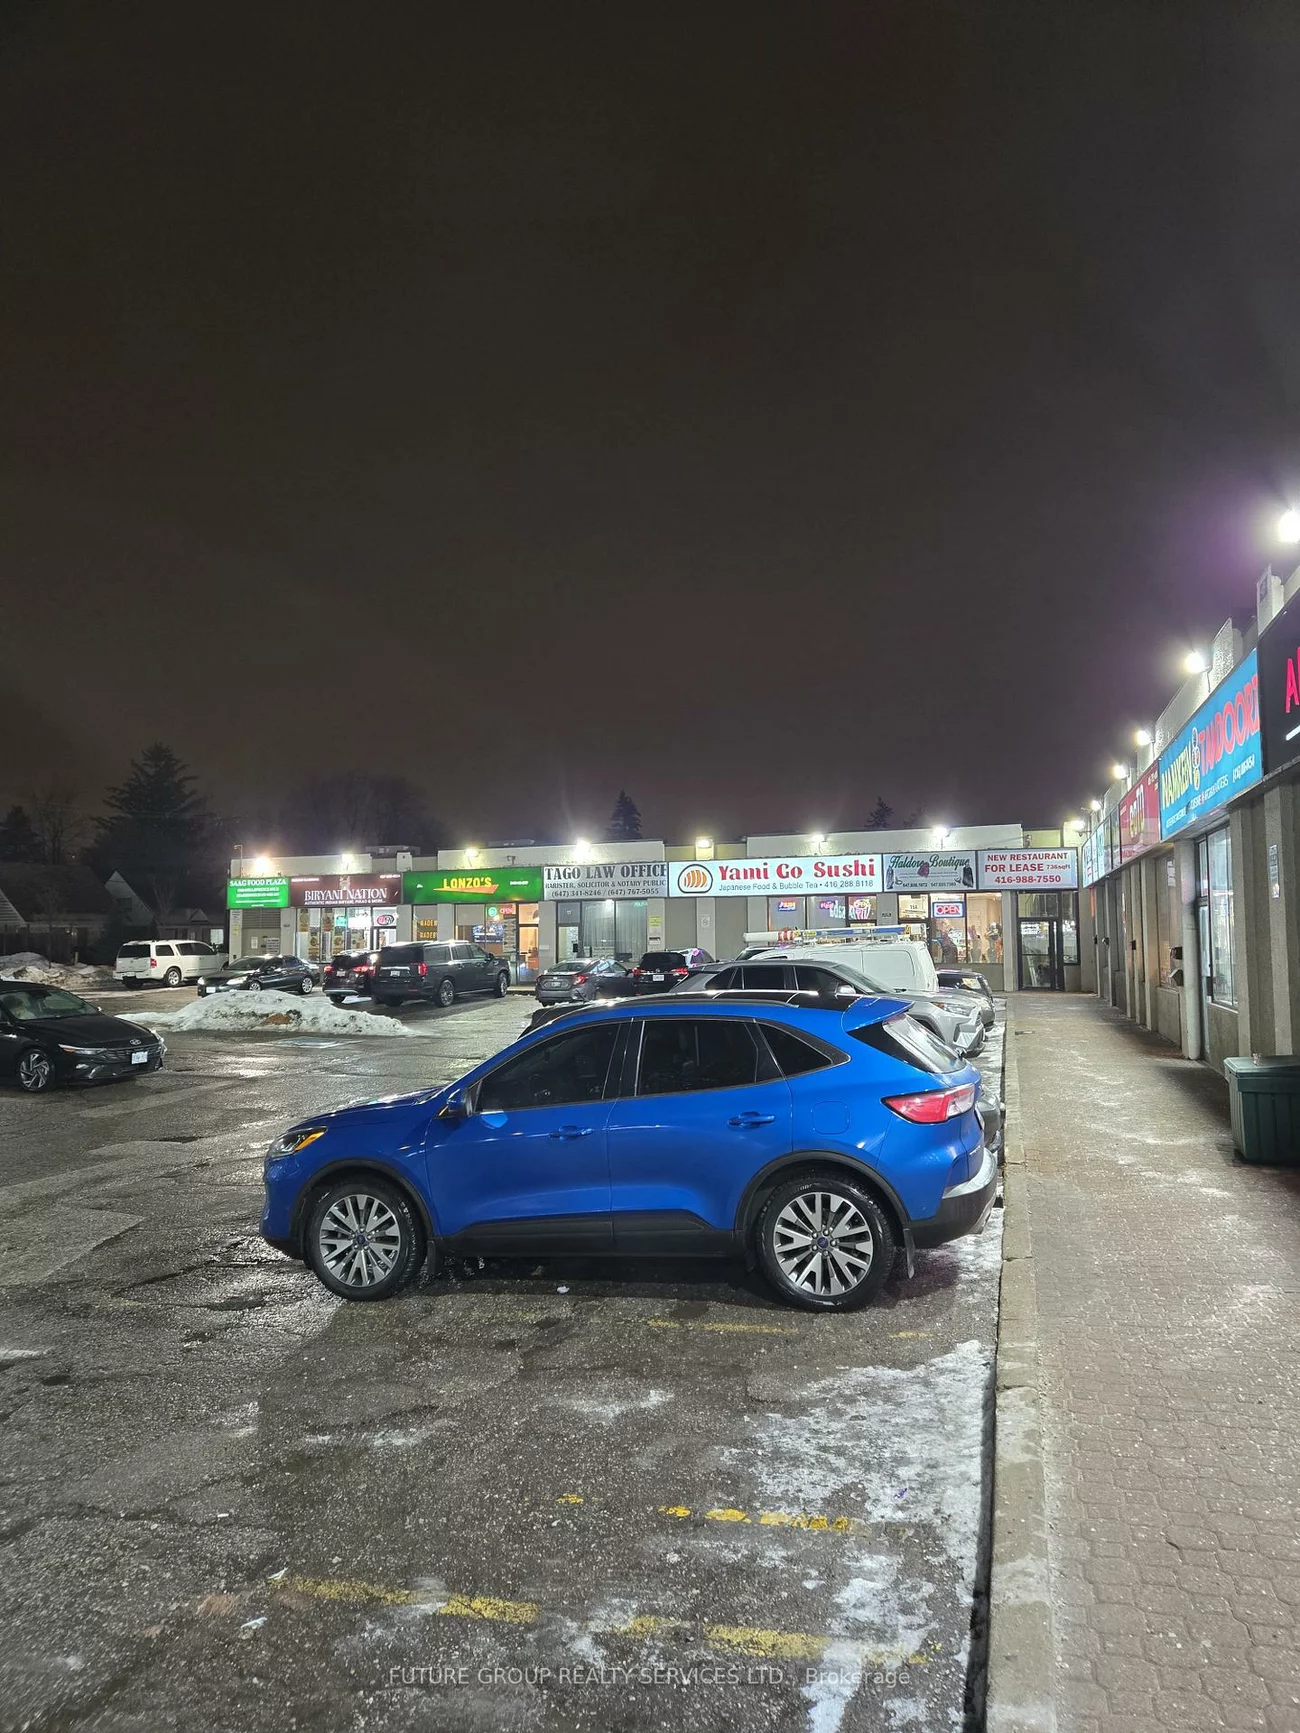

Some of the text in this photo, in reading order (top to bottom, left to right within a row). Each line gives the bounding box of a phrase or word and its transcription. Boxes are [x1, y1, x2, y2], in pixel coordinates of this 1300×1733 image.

[930, 854, 970, 870] Boutique
[718, 858, 876, 880] Yami Go Sushi
[985, 864, 1006, 872] FOR
[1010, 863, 1044, 872] LEASE
[545, 867, 581, 880] TAGO
[586, 866, 616, 879] LAW
[266, 878, 287, 886] PLAZA
[443, 877, 492, 889] LONZO'S
[995, 875, 1061, 884] 416-988-7550
[718, 884, 752, 892] Japanese
[752, 882, 770, 890] Food
[304, 888, 388, 901] BIRYANI NATION
[552, 890, 570, 898] (647)
[608, 888, 626, 896] (647)
[936, 906, 960, 915] OPEN
